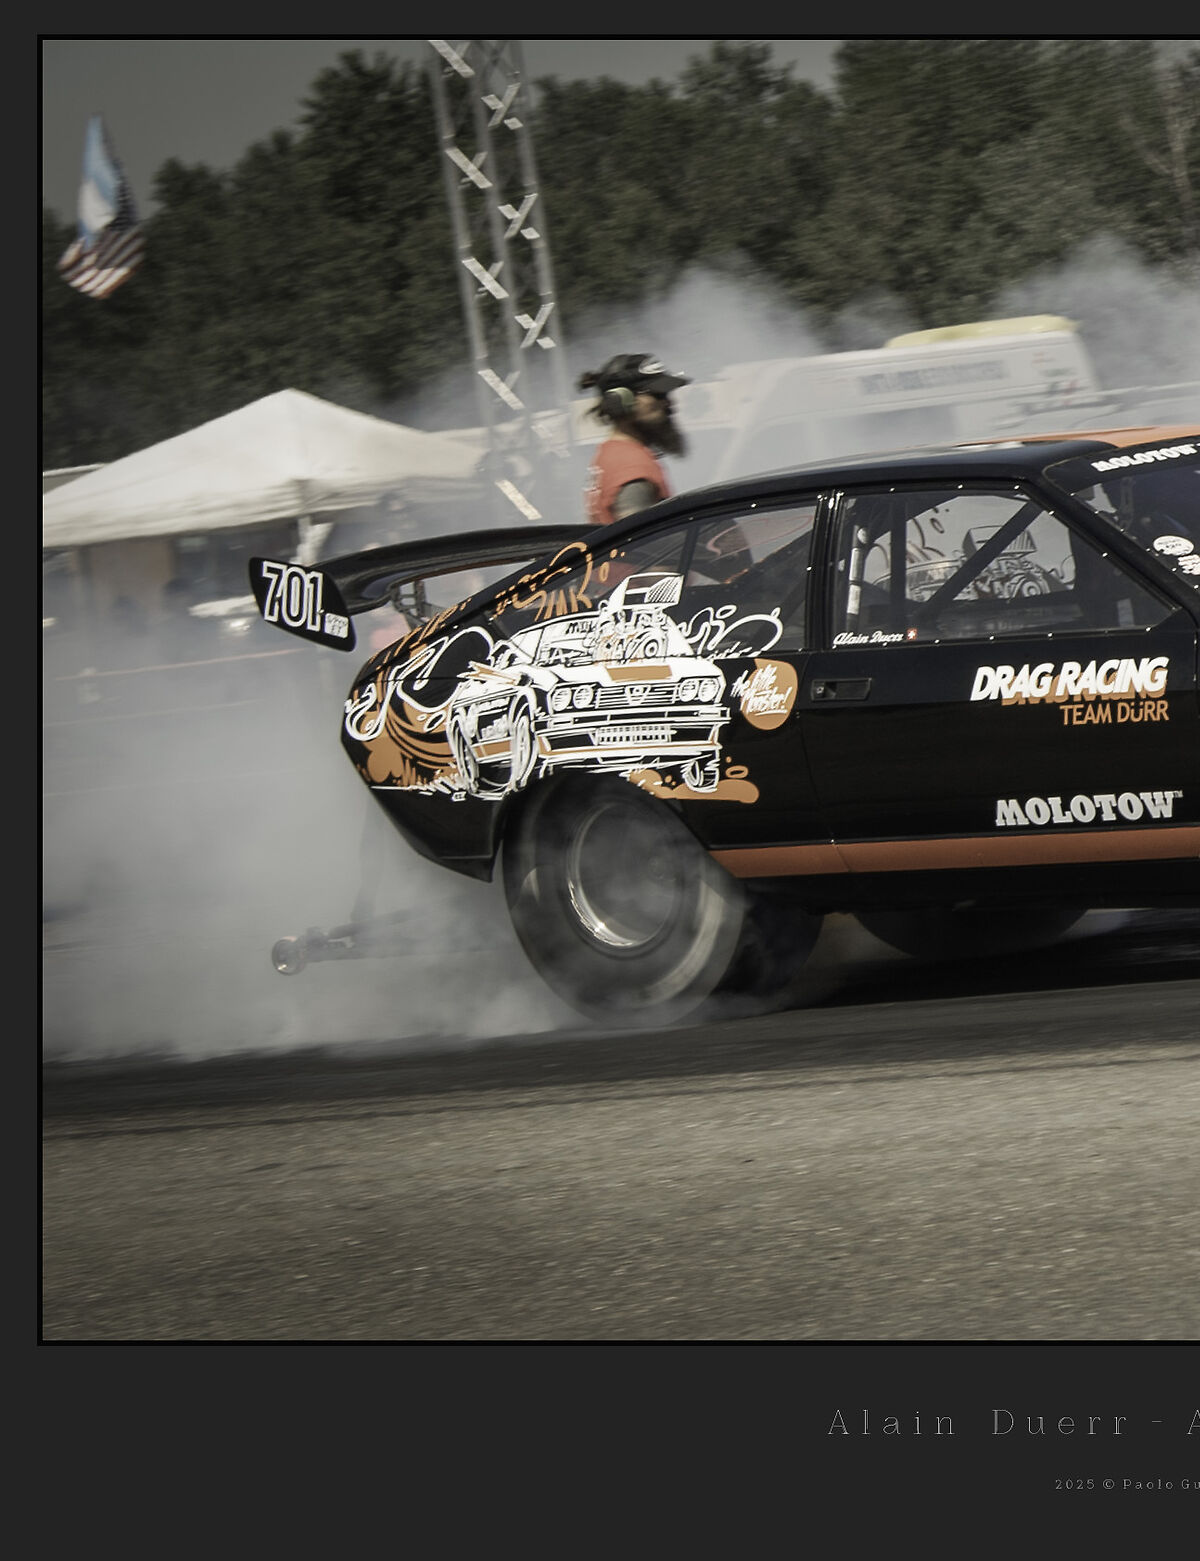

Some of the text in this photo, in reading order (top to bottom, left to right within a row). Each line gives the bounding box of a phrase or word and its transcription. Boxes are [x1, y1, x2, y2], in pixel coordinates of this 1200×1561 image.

[1091, 443, 1197, 472] MOLOTOW
[262, 560, 324, 631] 701
[833, 631, 869, 645] Alain
[970, 656, 1170, 702] DRAG RACING
[1060, 703, 1112, 726] TEAM
